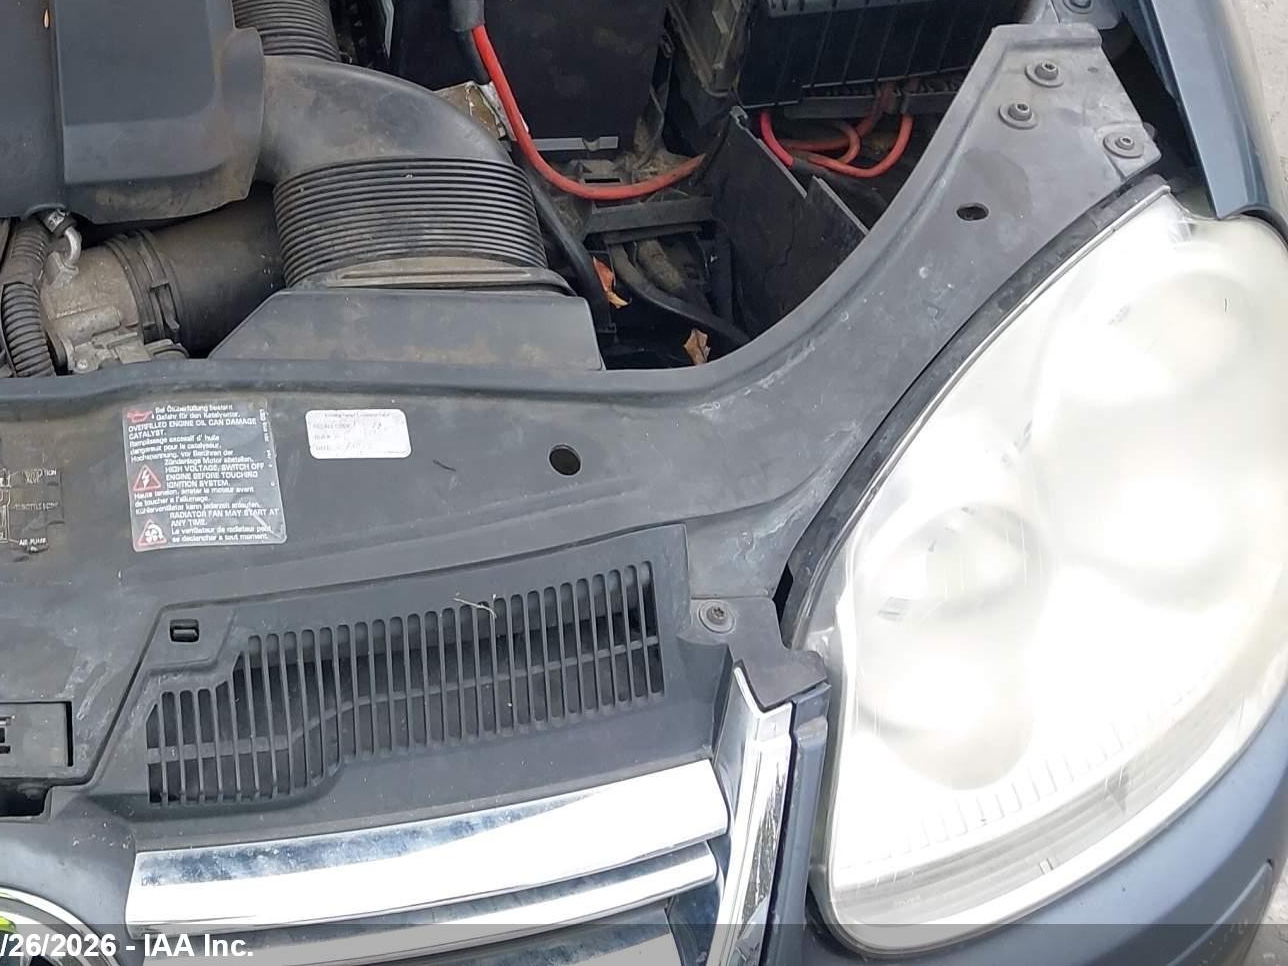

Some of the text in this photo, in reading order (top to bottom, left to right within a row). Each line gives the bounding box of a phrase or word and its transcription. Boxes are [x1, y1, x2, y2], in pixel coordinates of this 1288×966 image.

[128, 421, 167, 432] OVERFILLED
[251, 462, 264, 470] OFF
[193, 472, 220, 480] BEFORE
[170, 510, 206, 518] RADIATOR
[244, 508, 267, 516] START
[269, 508, 280, 516] AT
